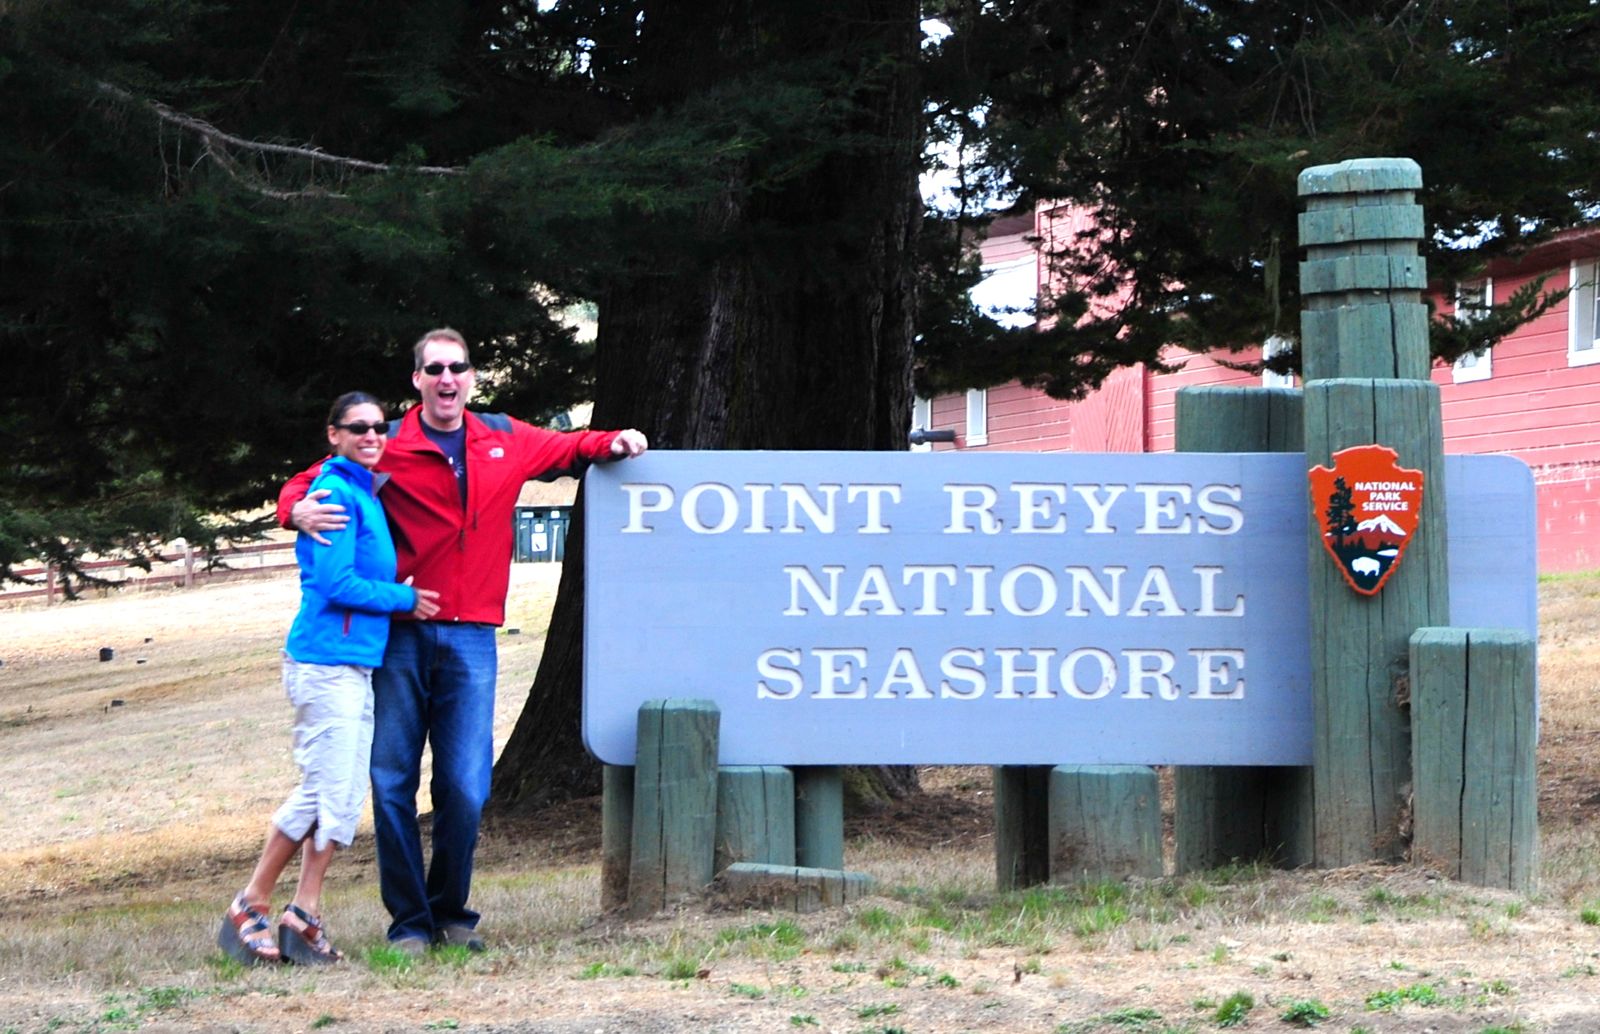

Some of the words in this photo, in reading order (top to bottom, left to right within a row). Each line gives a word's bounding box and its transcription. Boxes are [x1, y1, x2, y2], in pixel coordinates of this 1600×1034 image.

[1355, 481, 1416, 491] NATIONAL
[1369, 492, 1402, 501] PARK
[620, 482, 901, 535] POINT
[943, 482, 1245, 536] REYES
[1362, 501, 1409, 511] SERVICE
[782, 564, 1245, 618] NATIONAL
[756, 647, 1246, 701] SEASHORE
